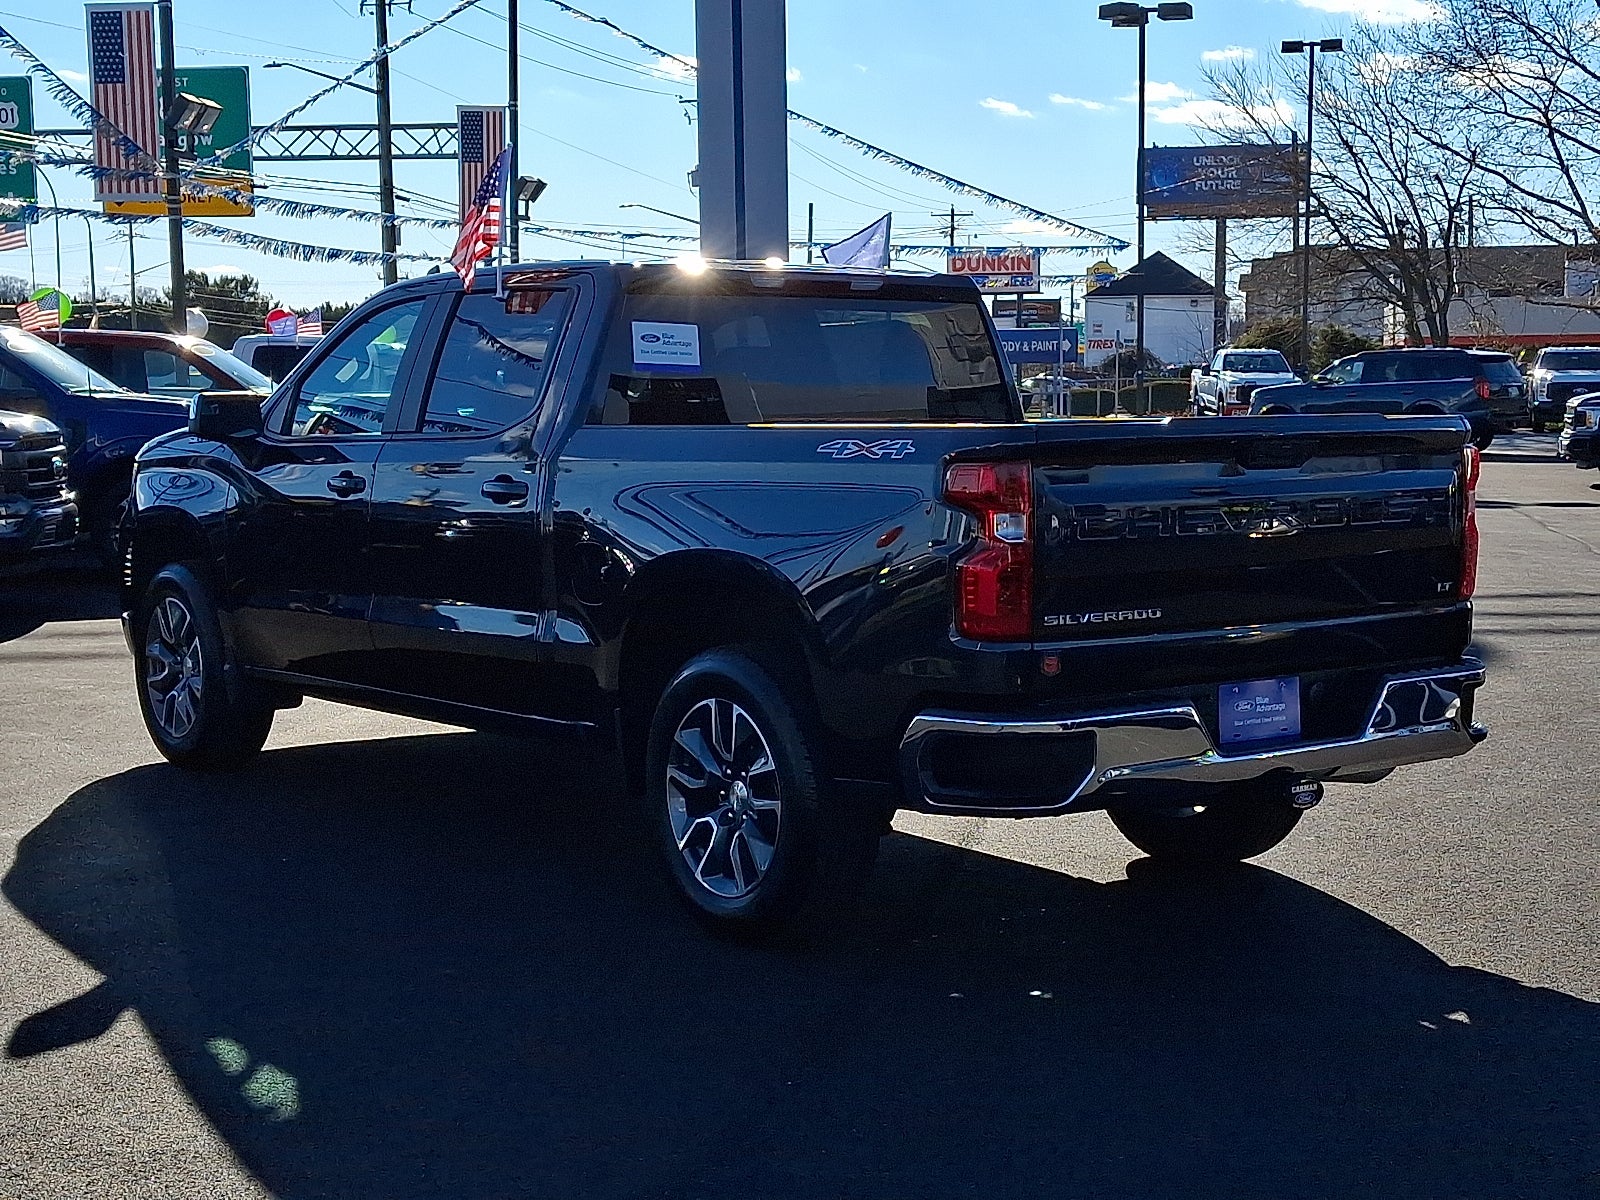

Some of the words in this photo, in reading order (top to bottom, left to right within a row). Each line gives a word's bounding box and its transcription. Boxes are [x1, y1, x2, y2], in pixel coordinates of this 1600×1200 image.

[1193, 155, 1242, 167] UNLOCK
[1198, 167, 1238, 179] YOUR
[1195, 180, 1242, 191] FUTURE
[1023, 341, 1029, 351] &
[1031, 340, 1059, 351] PAINT
[1087, 338, 1115, 350] TIRES
[1437, 581, 1454, 593] LT
[1043, 608, 1162, 626] SILVERADO
